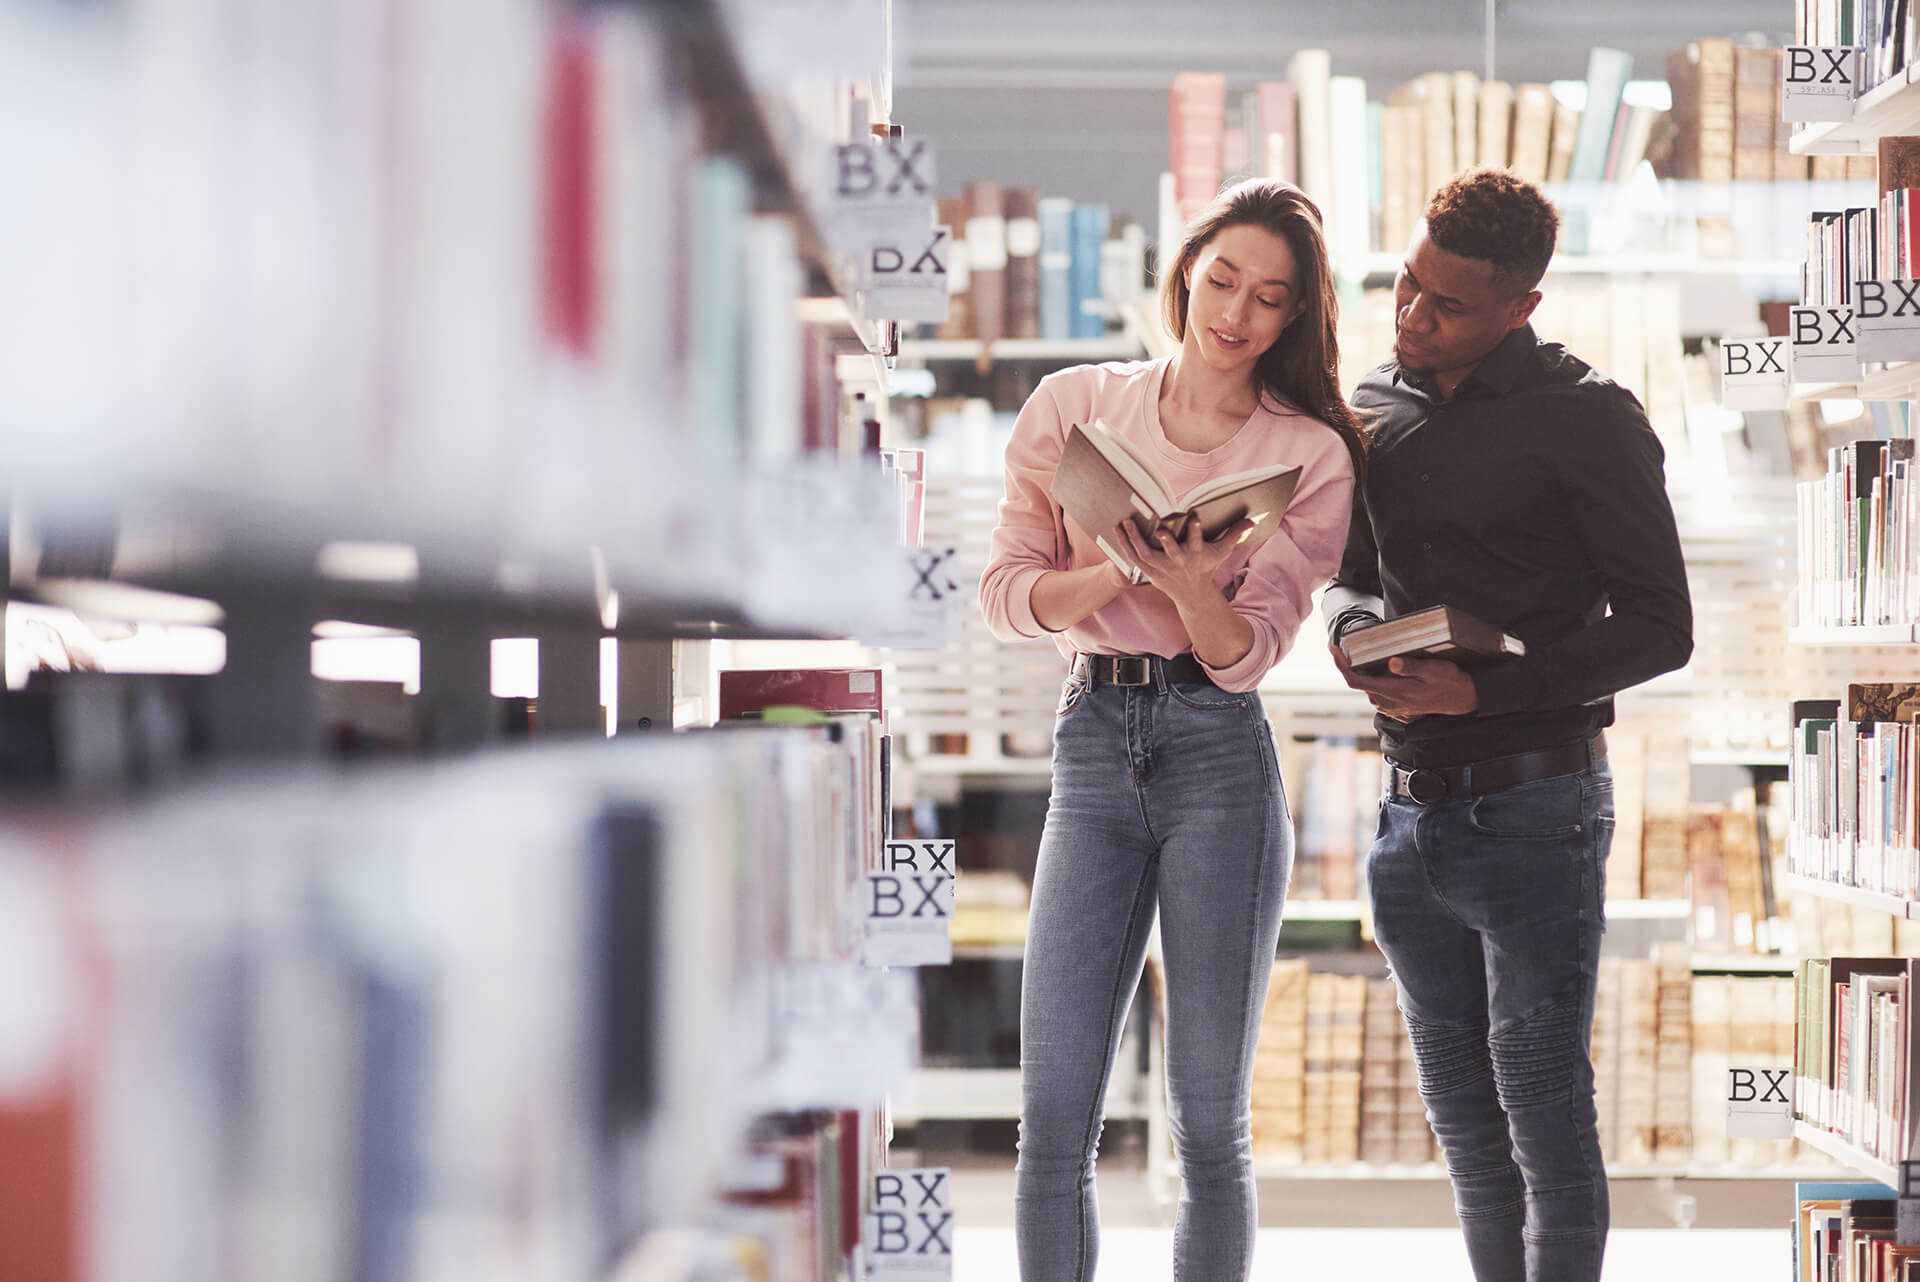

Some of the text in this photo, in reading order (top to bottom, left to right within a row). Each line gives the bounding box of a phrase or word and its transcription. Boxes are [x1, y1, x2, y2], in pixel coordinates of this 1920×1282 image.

[1785, 48, 1851, 84] BX
[834, 141, 928, 196] BX
[1855, 279, 1920, 318] BX
[1792, 309, 1855, 345] BX
[1723, 341, 1785, 375] BX
[868, 876, 947, 918] BX
[1728, 1069, 1789, 1103] BX
[872, 1212, 952, 1254] BX
